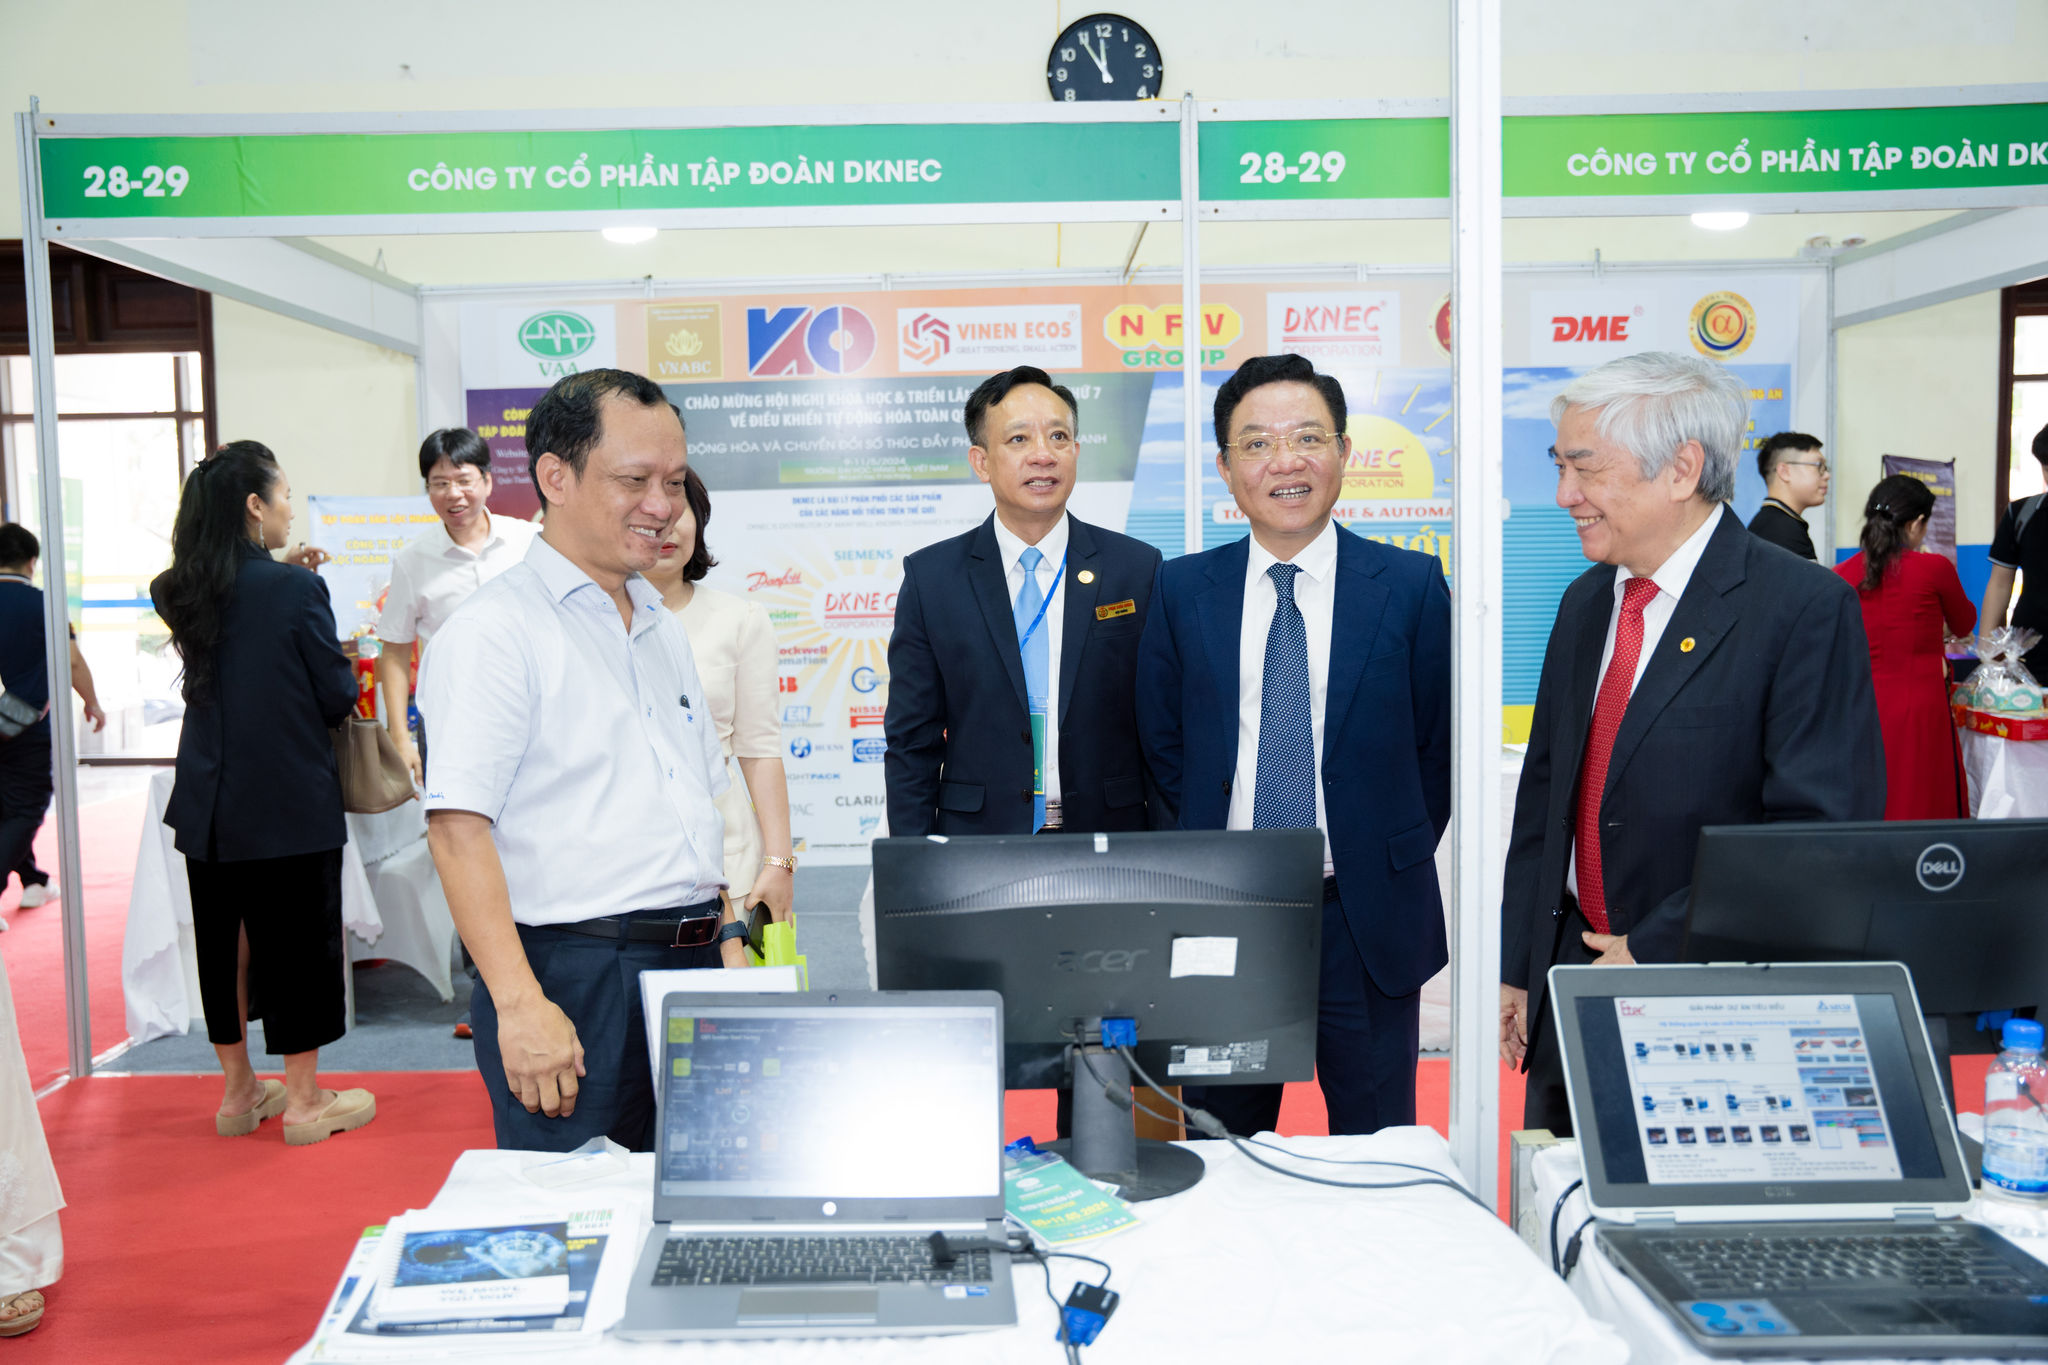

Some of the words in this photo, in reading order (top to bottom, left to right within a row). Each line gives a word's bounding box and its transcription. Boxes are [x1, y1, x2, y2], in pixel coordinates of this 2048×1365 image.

[1095, 24, 1112, 38] 12
[1121, 28, 1129, 42] 1
[1061, 47, 1076, 62] 10
[1134, 43, 1146, 58] 2
[1056, 67, 1068, 82] 9
[1142, 64, 1154, 78] 3
[1064, 88, 1076, 102] 8
[1136, 85, 1147, 99] 4
[1567, 147, 1656, 177] CÔNG
[1665, 151, 1697, 175] TY
[1706, 138, 1752, 174] CỔ
[1760, 137, 1840, 173] PHẦN
[1849, 141, 1902, 177] TẬP
[1911, 138, 1999, 171] ĐOÀN
[407, 162, 497, 191] CÔNG
[506, 166, 537, 189] TY
[545, 153, 592, 189] CỔ
[600, 152, 679, 188] PHẦN
[688, 156, 740, 192] TẬP
[748, 154, 835, 185] ĐOÀN
[844, 158, 942, 184] DKNEC
[1239, 151, 1346, 184] 28-29
[83, 165, 189, 198] 28-29
[1283, 305, 1381, 333] DKNEC
[956, 322, 1017, 341] VINEN
[1025, 321, 1071, 340] ECOS
[1551, 316, 1630, 342] DME
[1121, 350, 1227, 367] GROP
[685, 394, 720, 410] CHÀO
[722, 392, 763, 408] MỪNG
[765, 391, 789, 411] HỘI
[791, 392, 825, 409] NGHỊ
[908, 386, 947, 404] TRIỂN
[1093, 386, 1102, 400] 7
[729, 411, 746, 428] VỀ
[914, 408, 955, 425] TOÀN
[477, 423, 498, 440] TẬP
[1361, 507, 1374, 518] &
[834, 548, 894, 561] SIEMENS
[779, 645, 828, 656] ockwell
[1922, 861, 1958, 875] DELL
[1053, 948, 1149, 973] acer
